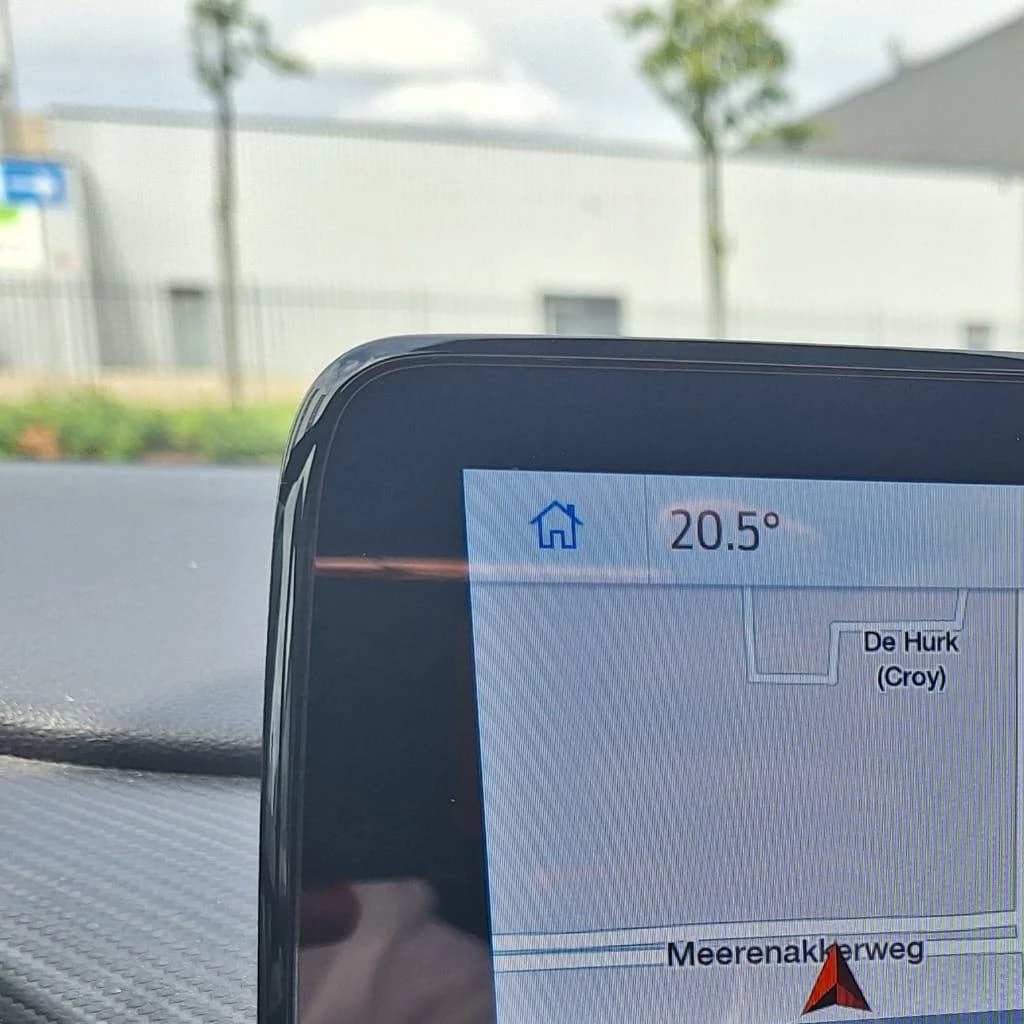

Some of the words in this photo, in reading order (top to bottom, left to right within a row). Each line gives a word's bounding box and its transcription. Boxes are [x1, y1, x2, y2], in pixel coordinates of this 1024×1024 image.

[669, 508, 780, 552] 20.5°
[863, 630, 896, 653] De
[904, 629, 960, 653] Hurk
[876, 664, 948, 692] (Croy)
